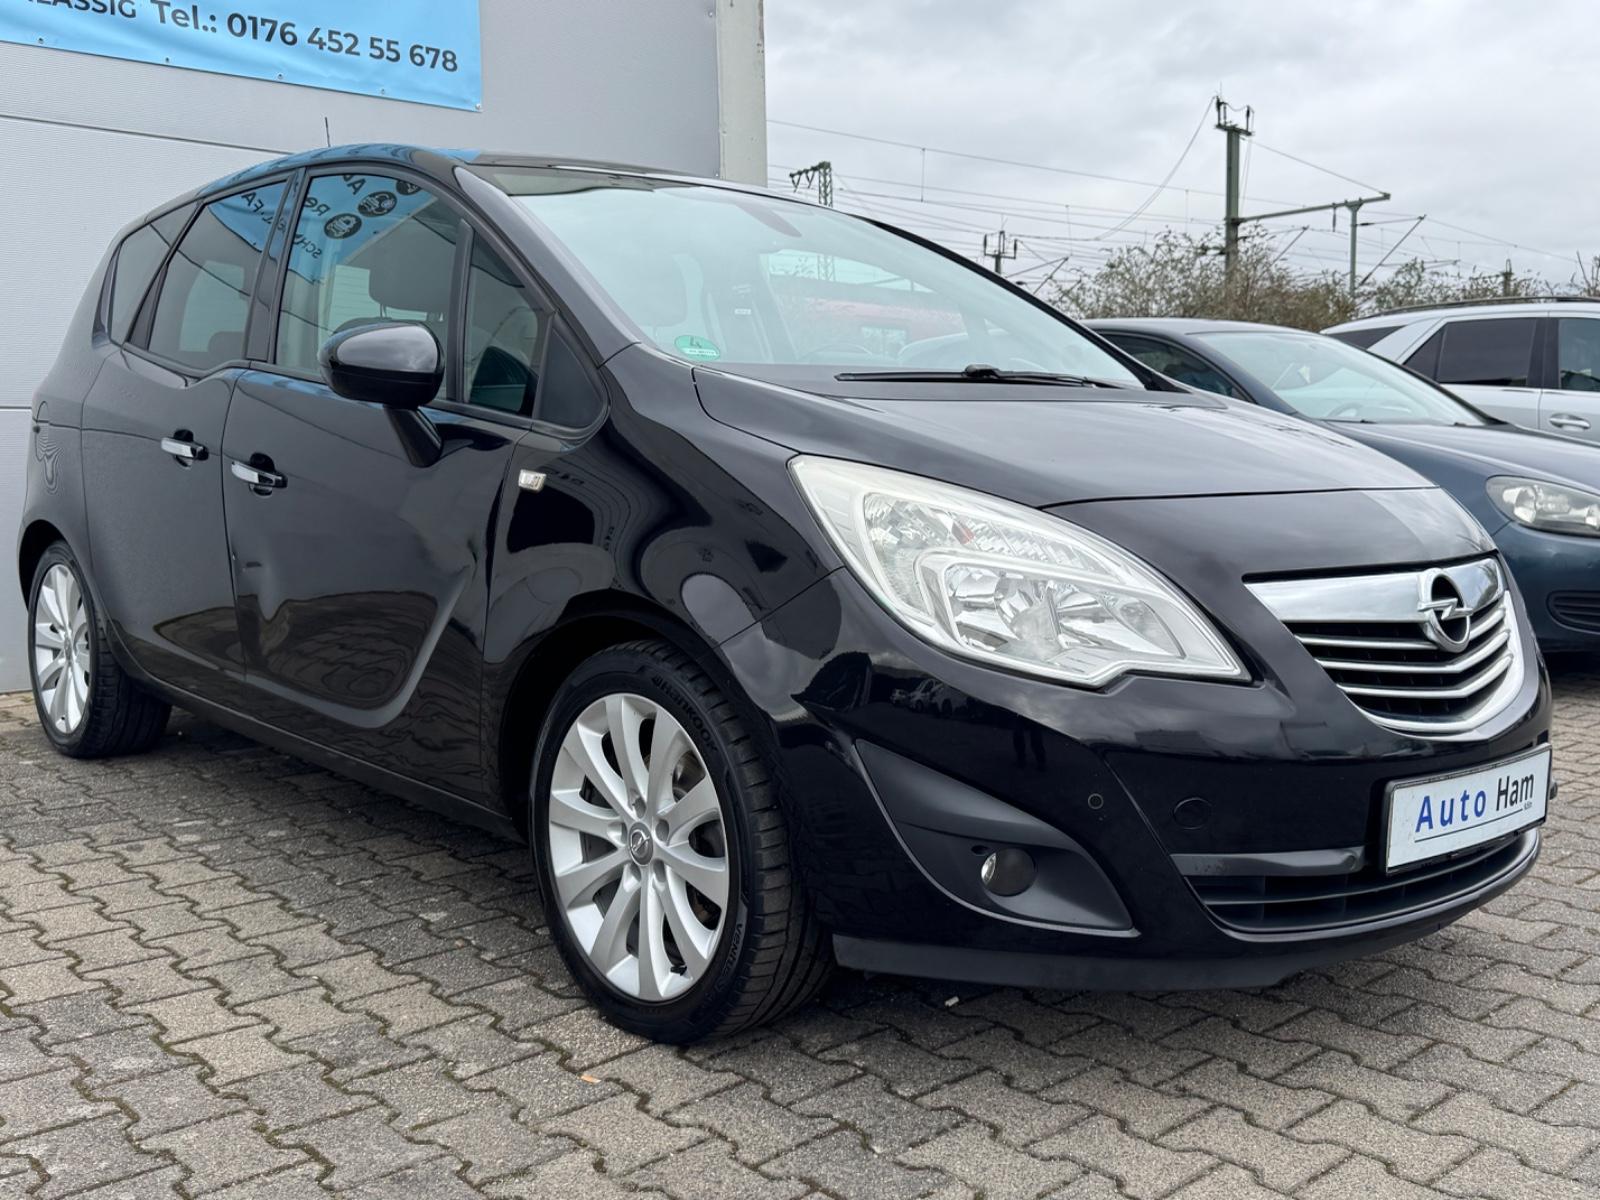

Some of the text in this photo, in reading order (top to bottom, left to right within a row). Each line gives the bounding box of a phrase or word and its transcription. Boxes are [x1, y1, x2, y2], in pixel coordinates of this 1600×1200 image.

[150, 0, 217, 33] Tel.:
[226, 12, 299, 47] 0176
[307, 27, 361, 56] 452
[369, 38, 402, 63] 55
[409, 44, 459, 73] 678
[1415, 774, 1535, 833] Auto Ham
